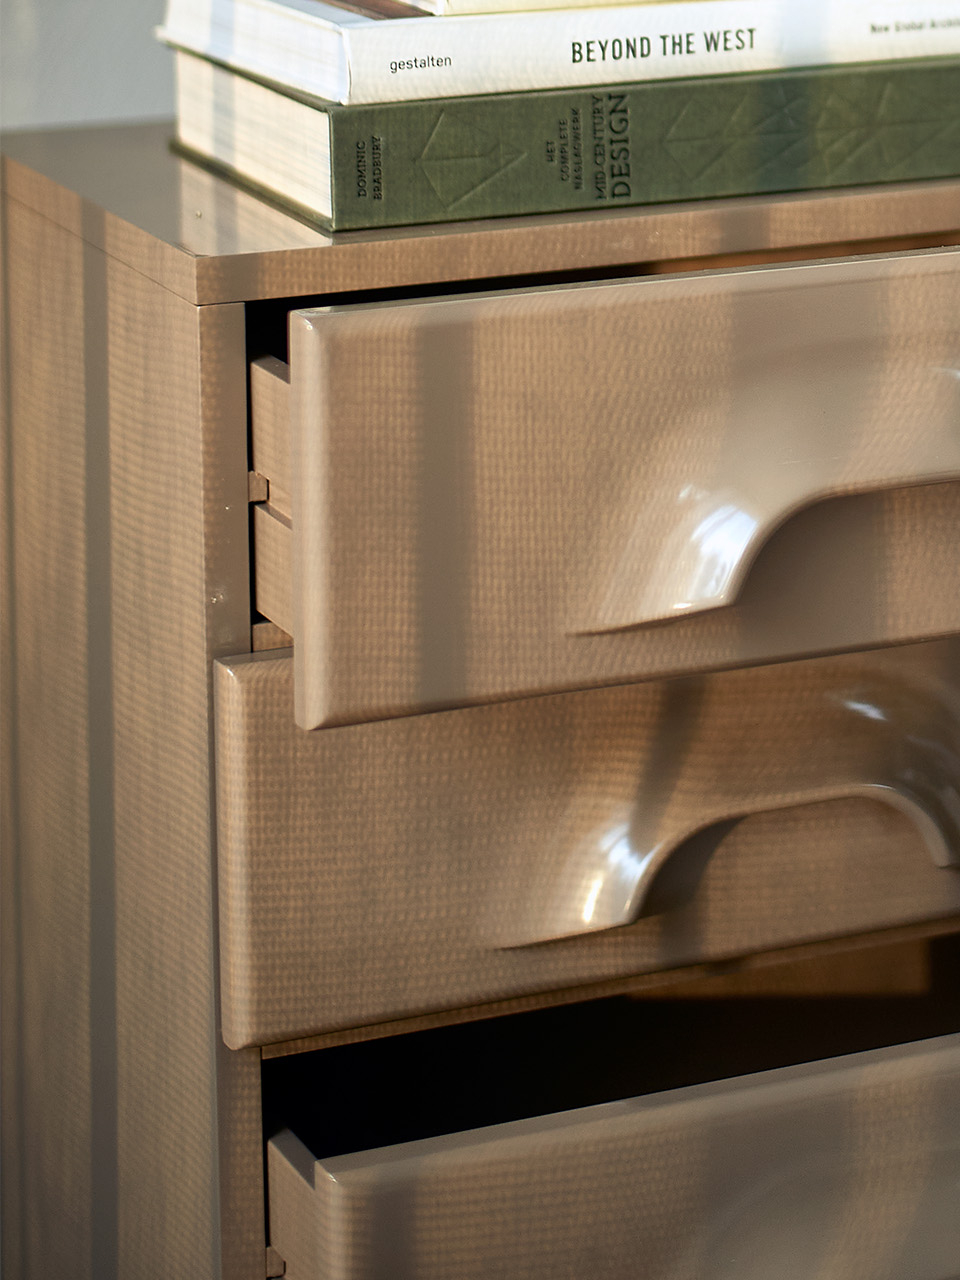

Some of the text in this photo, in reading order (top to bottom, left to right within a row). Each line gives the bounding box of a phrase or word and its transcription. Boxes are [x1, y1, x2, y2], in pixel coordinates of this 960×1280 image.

[389, 54, 452, 74] gestalten
[571, 28, 758, 64] BEYOND THE WEST
[356, 140, 367, 198] DOMINIC
[371, 135, 383, 200] BRADBURY
[546, 140, 556, 162] HET
[559, 119, 570, 182] COMPLETE
[571, 107, 583, 190] NASLAGWERK
[608, 93, 632, 199] DESIGN
